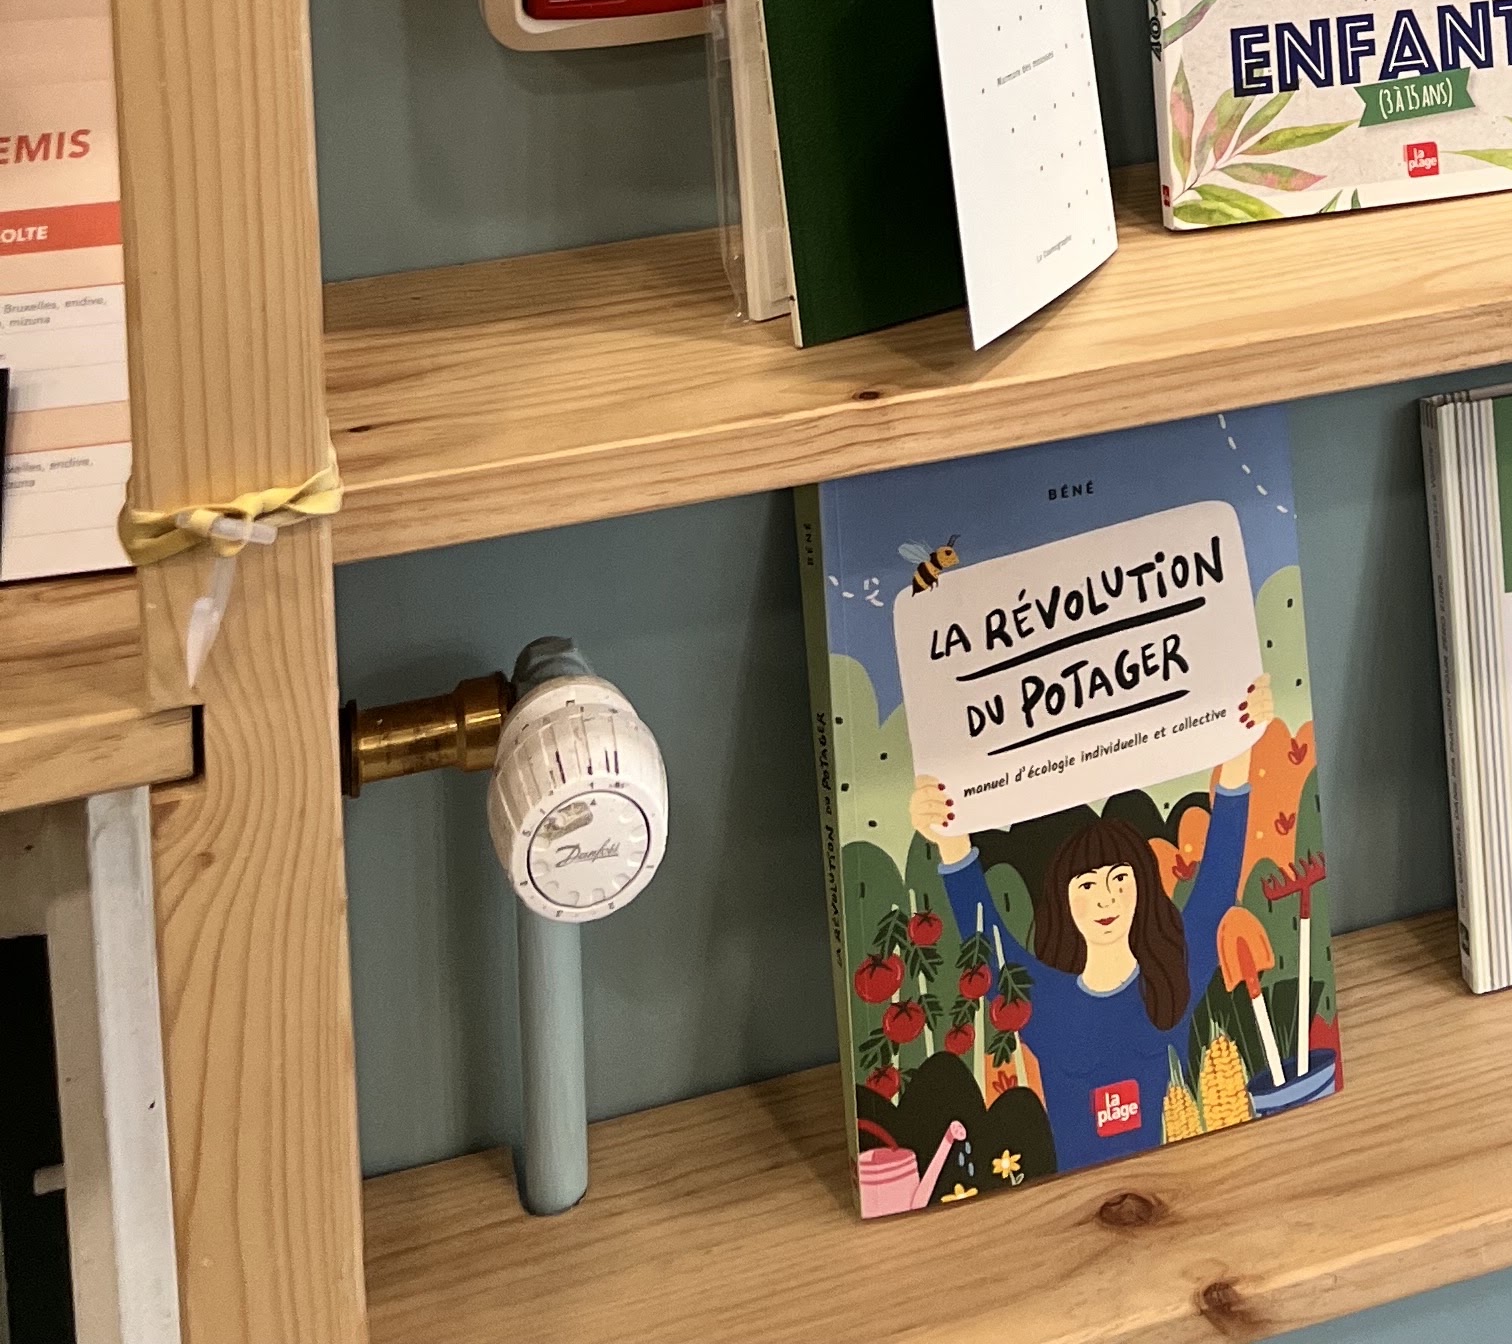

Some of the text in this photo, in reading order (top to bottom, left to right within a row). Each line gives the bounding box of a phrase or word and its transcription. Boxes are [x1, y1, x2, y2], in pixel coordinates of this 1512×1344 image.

[1408, 155, 1437, 173] plage
[1414, 147, 1424, 158] la
[1048, 480, 1095, 500] BÉNÉ
[930, 623, 971, 660] LA
[966, 634, 1190, 737] DU POTAGER
[963, 707, 1227, 798] manuel d'écologie individuelle et collective
[1105, 1090, 1121, 1108] la
[1097, 1100, 1138, 1127] plage
